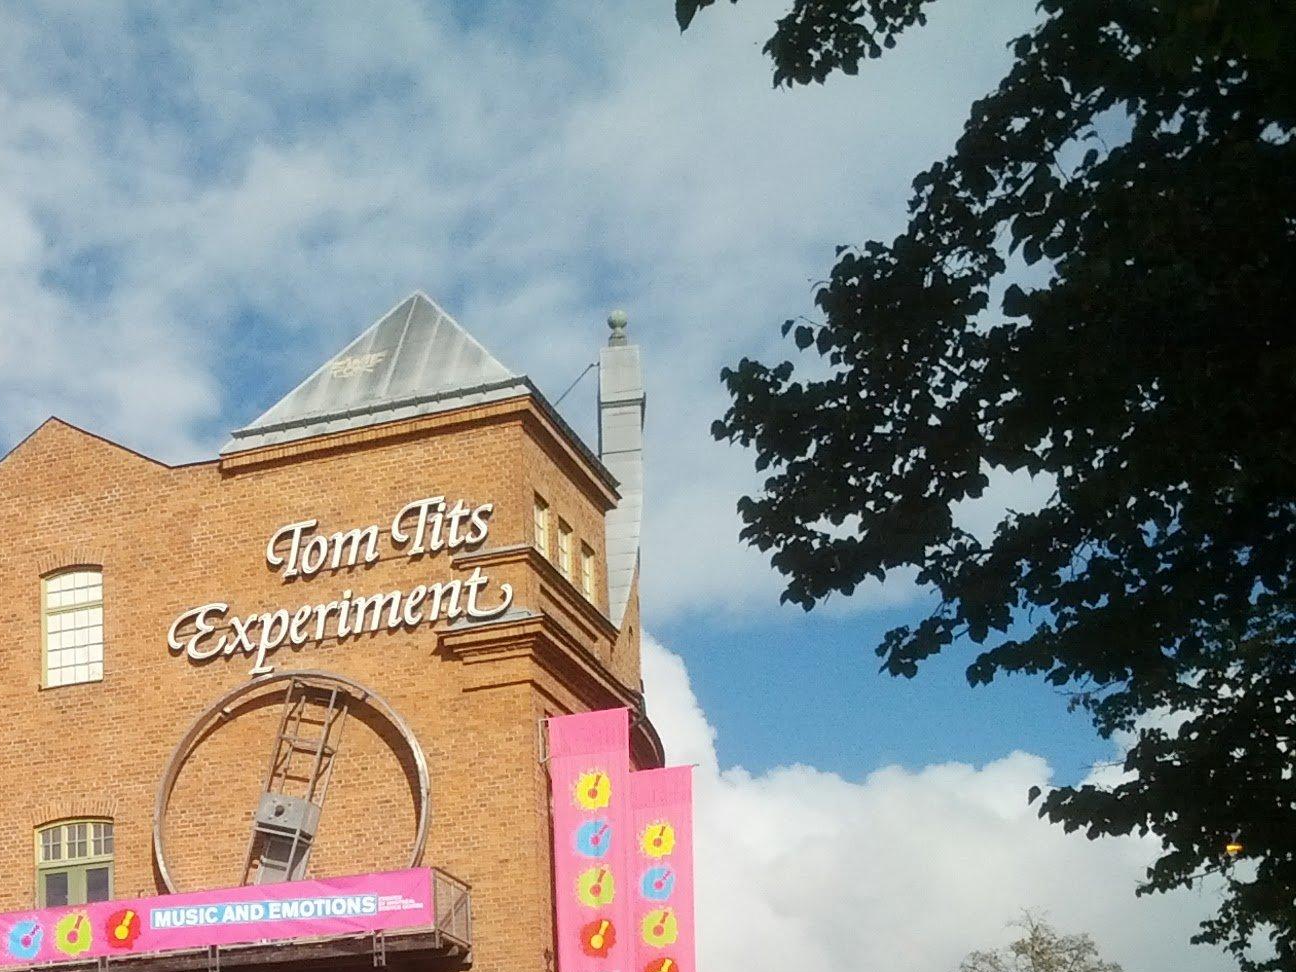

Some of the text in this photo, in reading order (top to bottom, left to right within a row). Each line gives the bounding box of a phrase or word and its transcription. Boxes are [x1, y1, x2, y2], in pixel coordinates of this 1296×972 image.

[266, 495, 495, 579] Tom Tits
[167, 566, 514, 676] Experiment
[154, 908, 220, 929] MUSIC
[216, 904, 264, 923] AND
[268, 895, 377, 920] EMOTIONS
